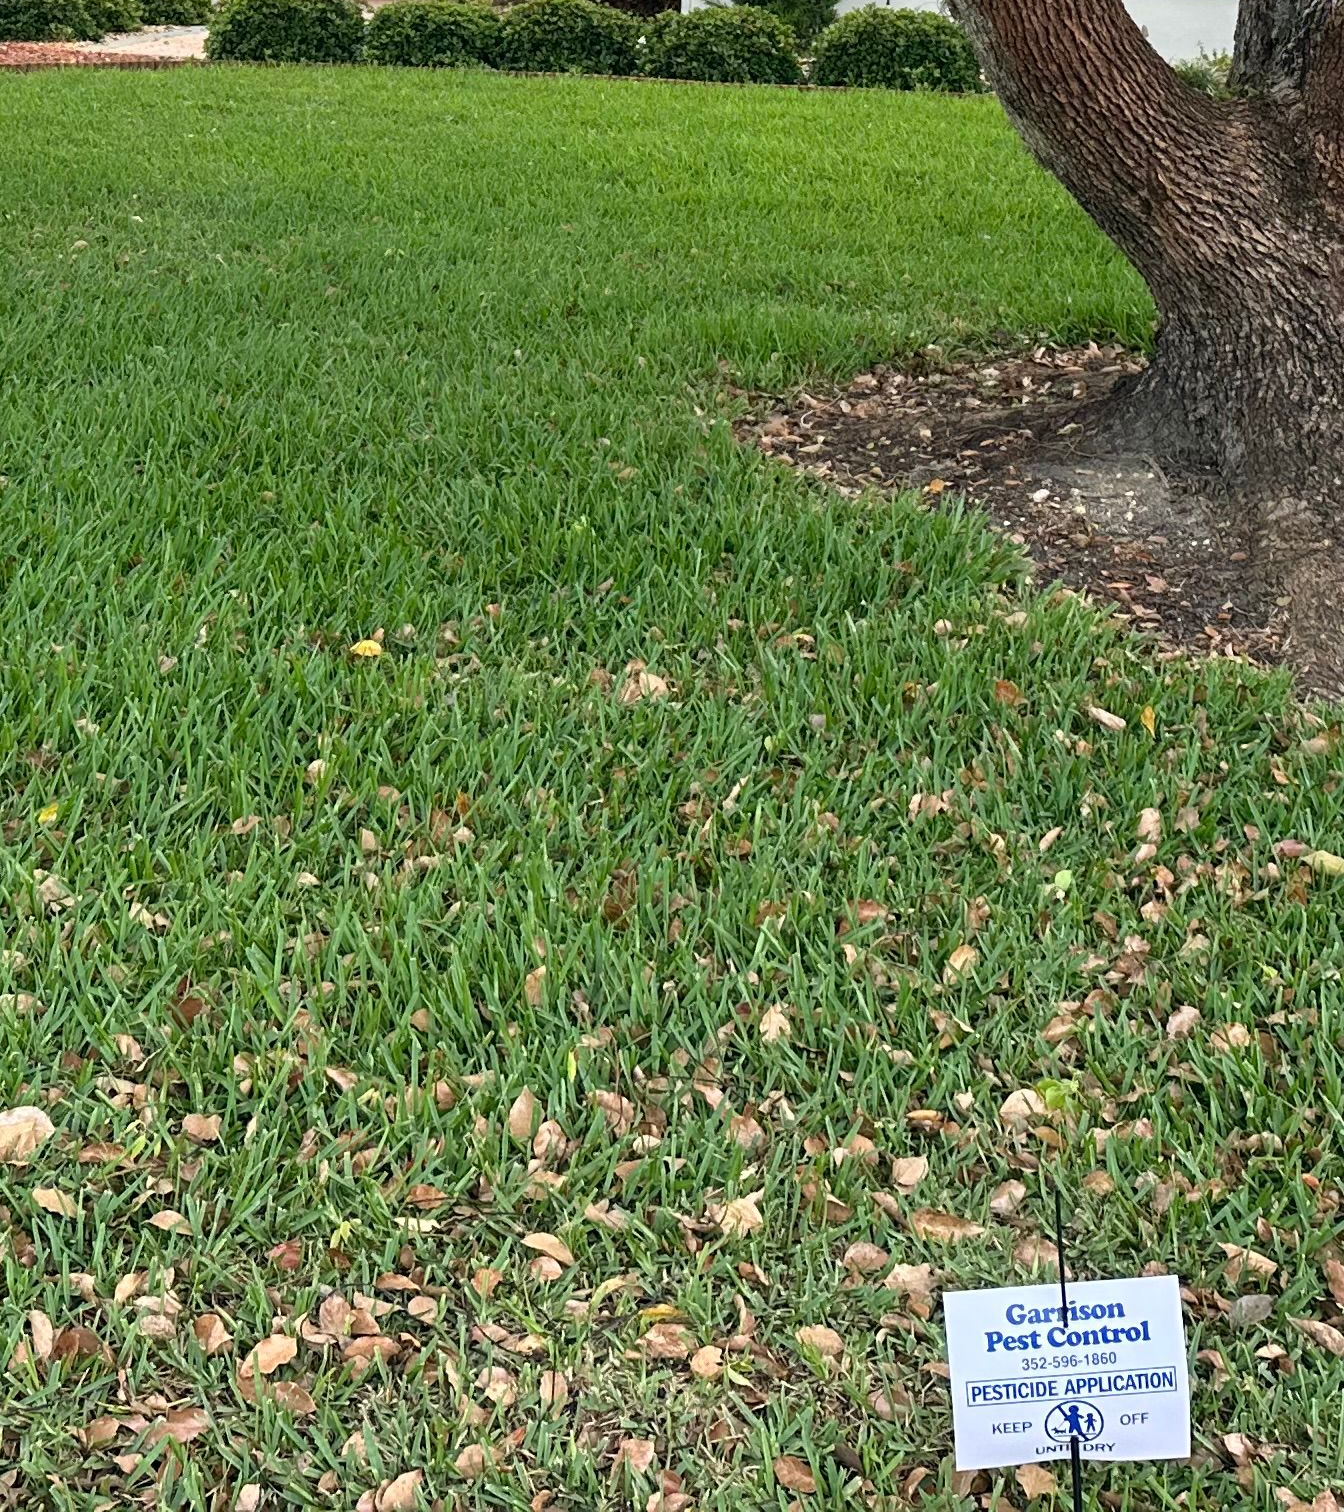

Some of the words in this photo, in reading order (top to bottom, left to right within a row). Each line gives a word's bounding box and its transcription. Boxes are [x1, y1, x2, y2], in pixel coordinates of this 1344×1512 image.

[985, 1327, 1041, 1352] Pest
[1047, 1320, 1151, 1348] Control
[1021, 1351, 1117, 1371] 352-596-1860
[971, 1380, 1059, 1403] PESTICIDE
[1064, 1371, 1174, 1396] APPLICATION
[992, 1421, 1032, 1435] KEEP
[1119, 1412, 1149, 1426] OFF
[1035, 1443, 1080, 1455] UNTI
[1083, 1442, 1116, 1452] DRY
